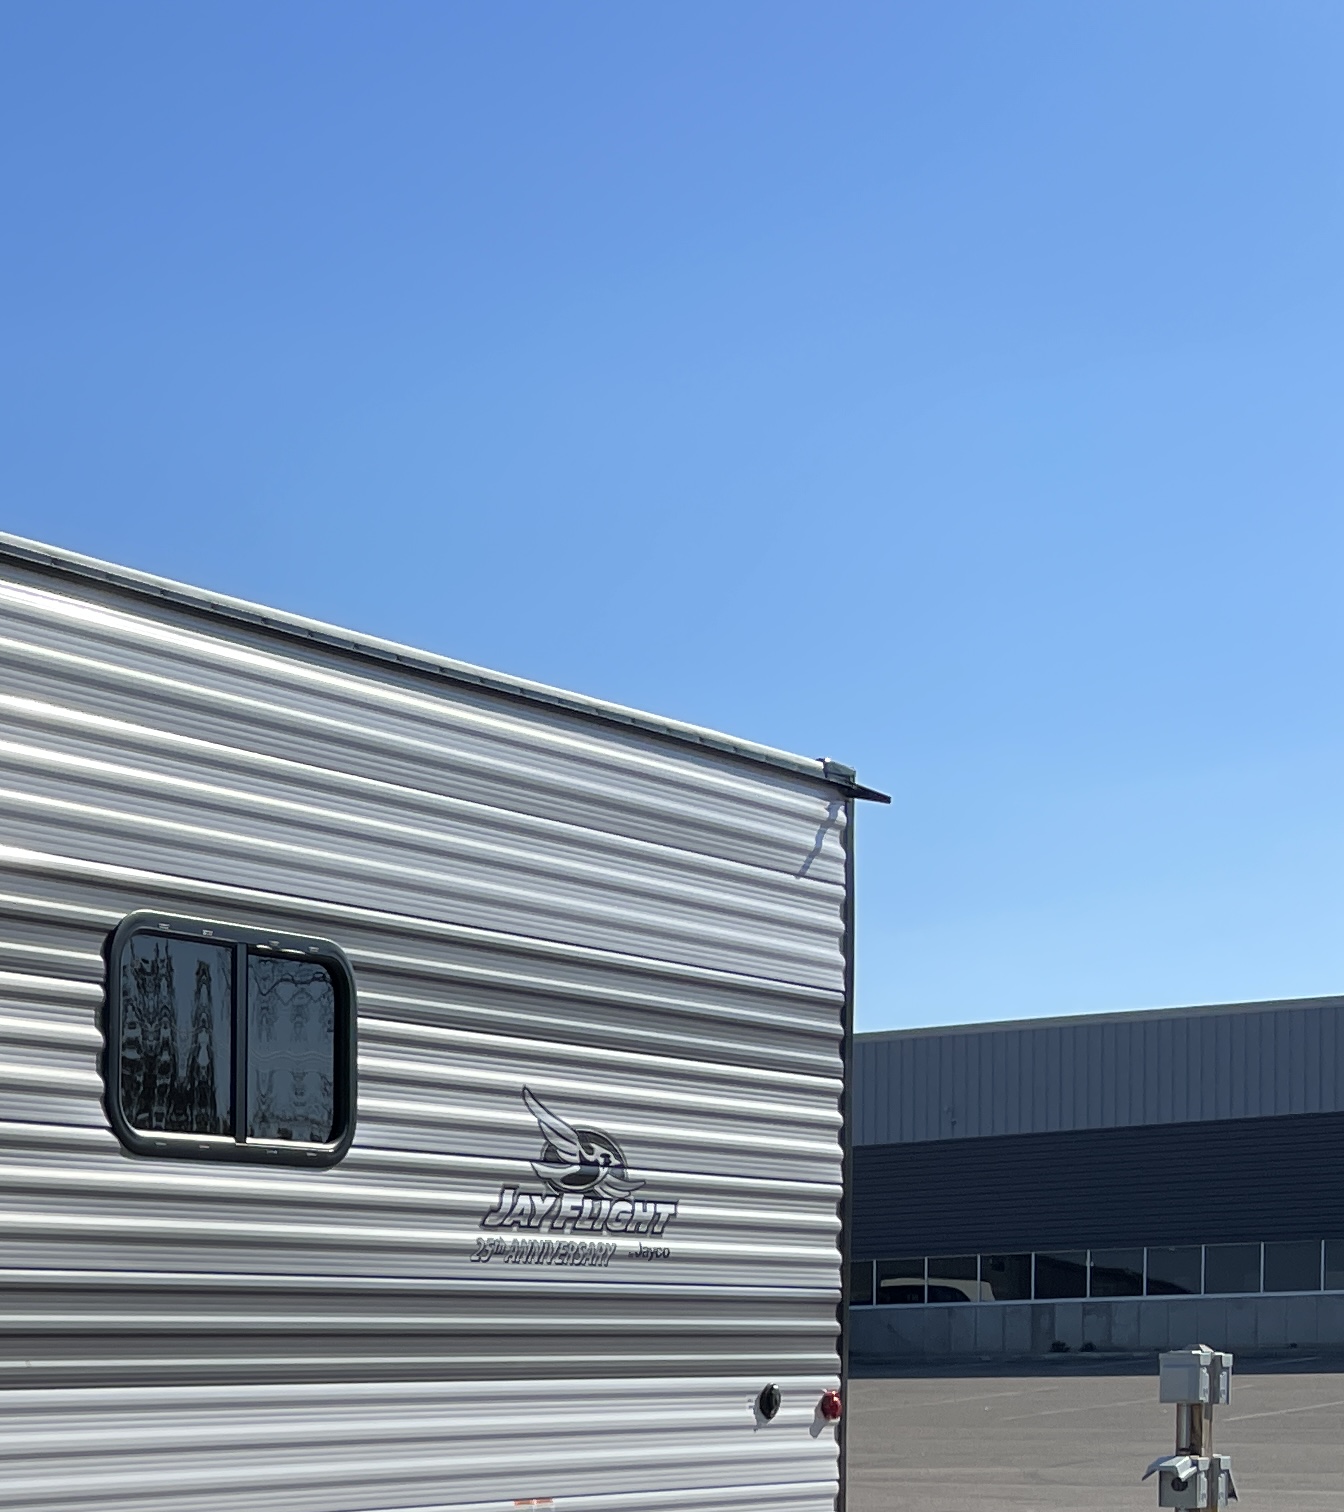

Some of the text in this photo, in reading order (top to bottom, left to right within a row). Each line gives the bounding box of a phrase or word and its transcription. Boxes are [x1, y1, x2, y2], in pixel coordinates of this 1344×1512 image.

[481, 1186, 678, 1234] JAY FLIGHT
[504, 1238, 617, 1267] ANNIVERSARY
[635, 1242, 671, 1261] Jayco
